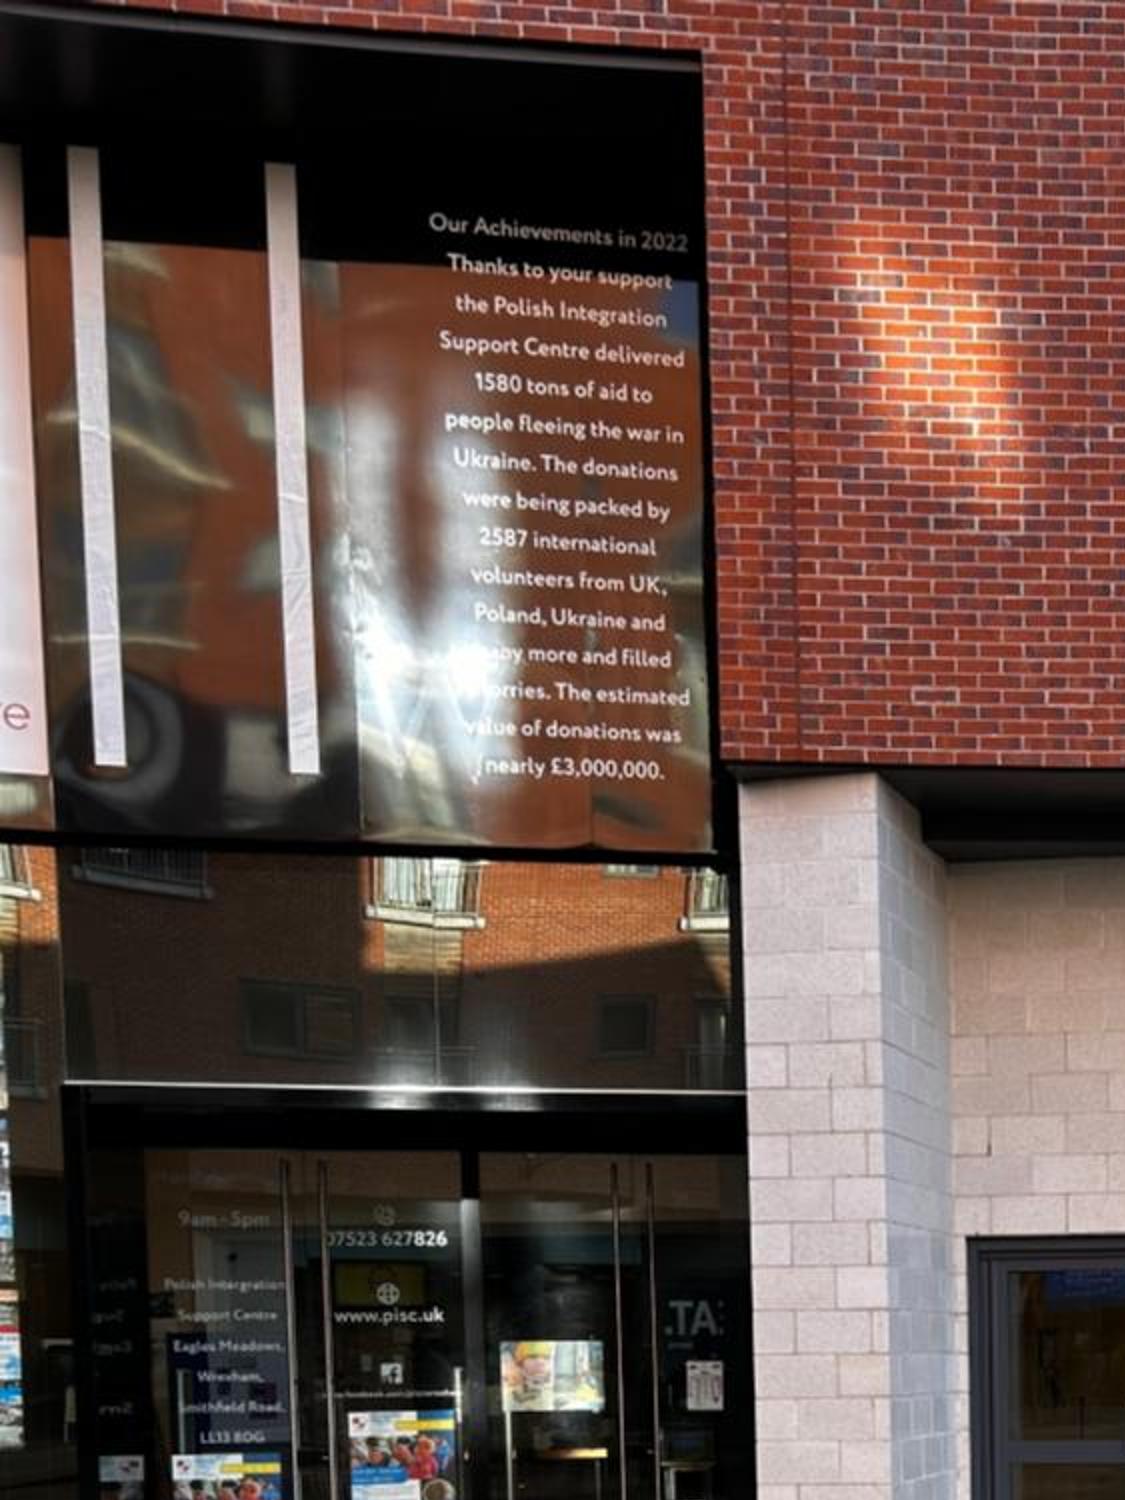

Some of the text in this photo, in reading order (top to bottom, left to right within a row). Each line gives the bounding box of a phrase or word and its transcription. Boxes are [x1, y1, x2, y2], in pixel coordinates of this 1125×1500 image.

[429, 212, 689, 252] Our Achievements in 2022
[447, 252, 673, 290] Thanks to your support
[455, 295, 667, 328] the Polish Integration
[439, 330, 685, 368] Support Centre delivered
[475, 372, 653, 404] 1580 tons of aid to
[445, 412, 684, 443] people fleeing the war in
[453, 448, 679, 482] Ukraine. The donations
[462, 492, 670, 524] were being packed by
[479, 527, 657, 557] 2587 international
[471, 566, 668, 597] volunteers from UK,
[474, 602, 666, 632] Poland, Ukraine and
[528, 648, 578, 664] more
[582, 648, 617, 667] and
[621, 648, 672, 669] filled
[553, 682, 592, 702] The
[595, 687, 691, 707] estimated
[464, 719, 682, 743] value of donations was
[485, 756, 665, 780] nearly £3,000,000.
[381, 1230, 448, 1247] 627826
[334, 1305, 444, 1327] www.pisc.uk
